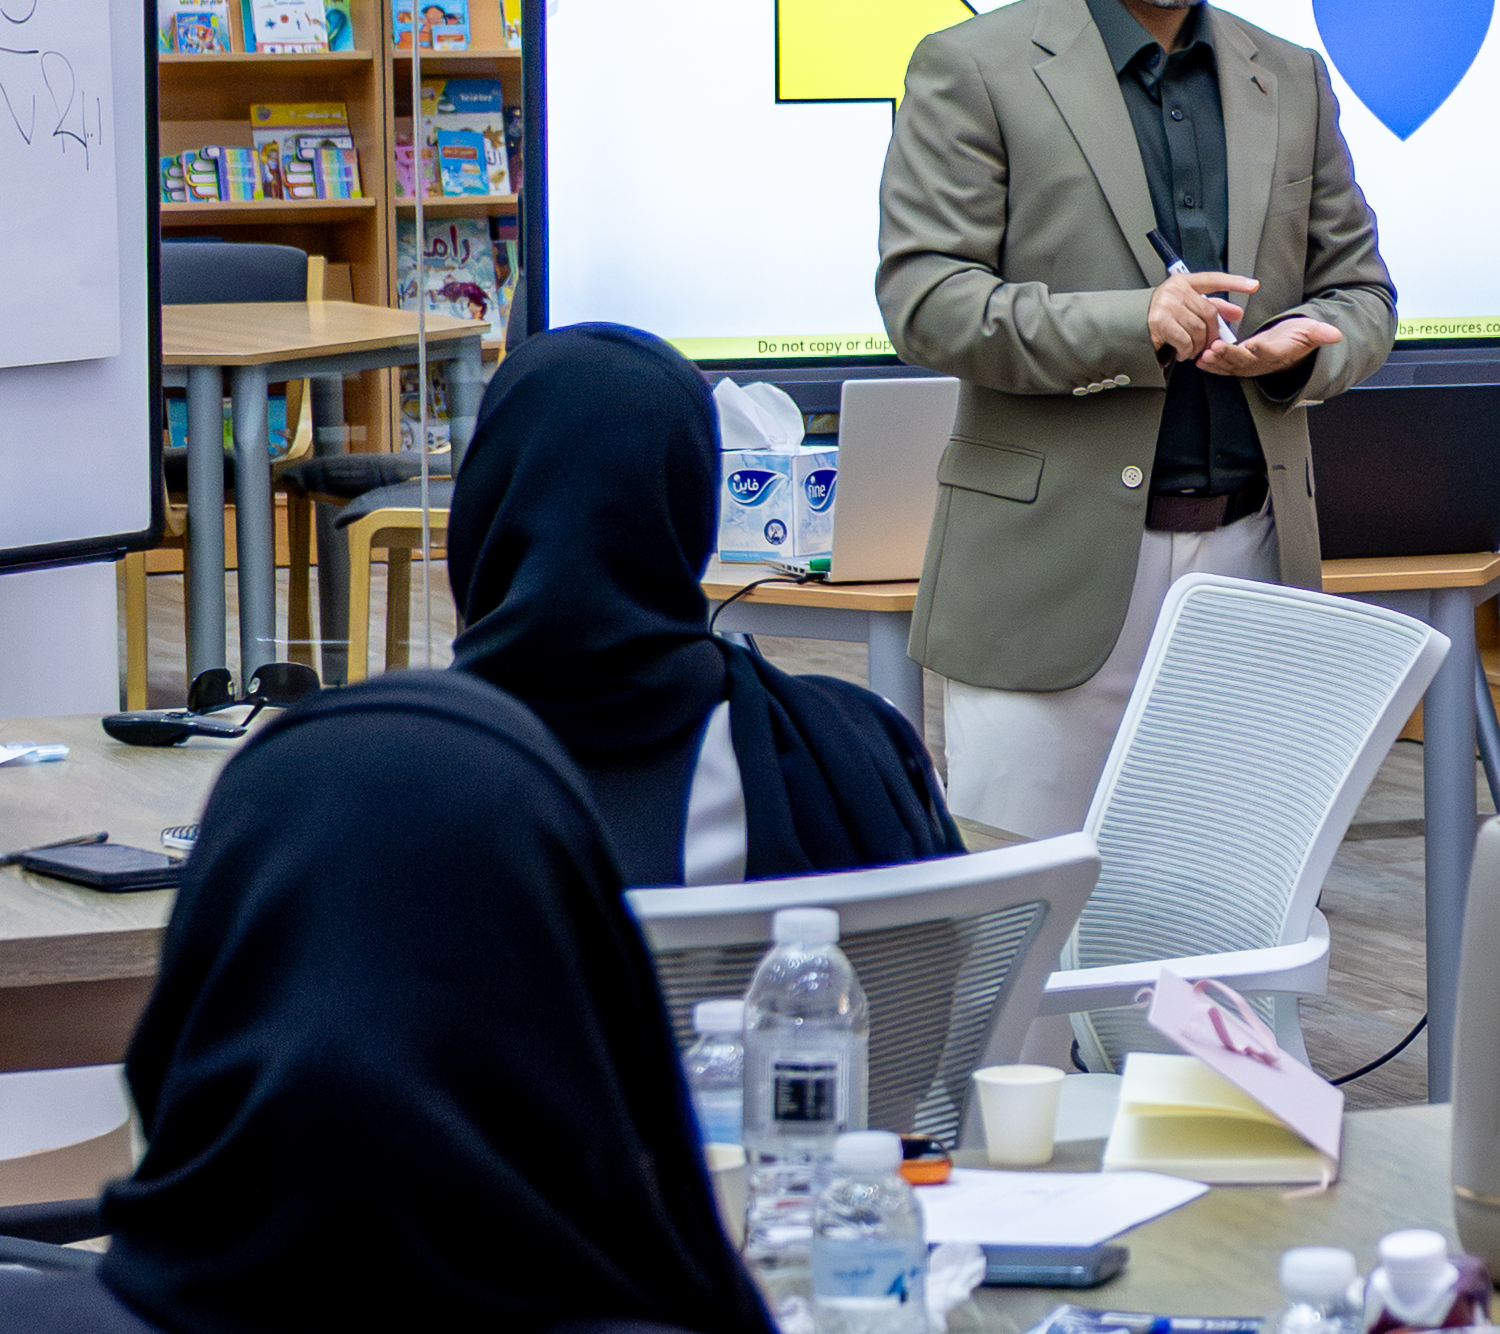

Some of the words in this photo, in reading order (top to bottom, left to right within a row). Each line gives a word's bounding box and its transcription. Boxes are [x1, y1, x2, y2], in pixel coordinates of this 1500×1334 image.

[758, 340, 777, 354] Do
[782, 342, 805, 353] not
[809, 341, 842, 355] copy
[846, 340, 861, 351] or
[733, 474, 760, 495] فاين
